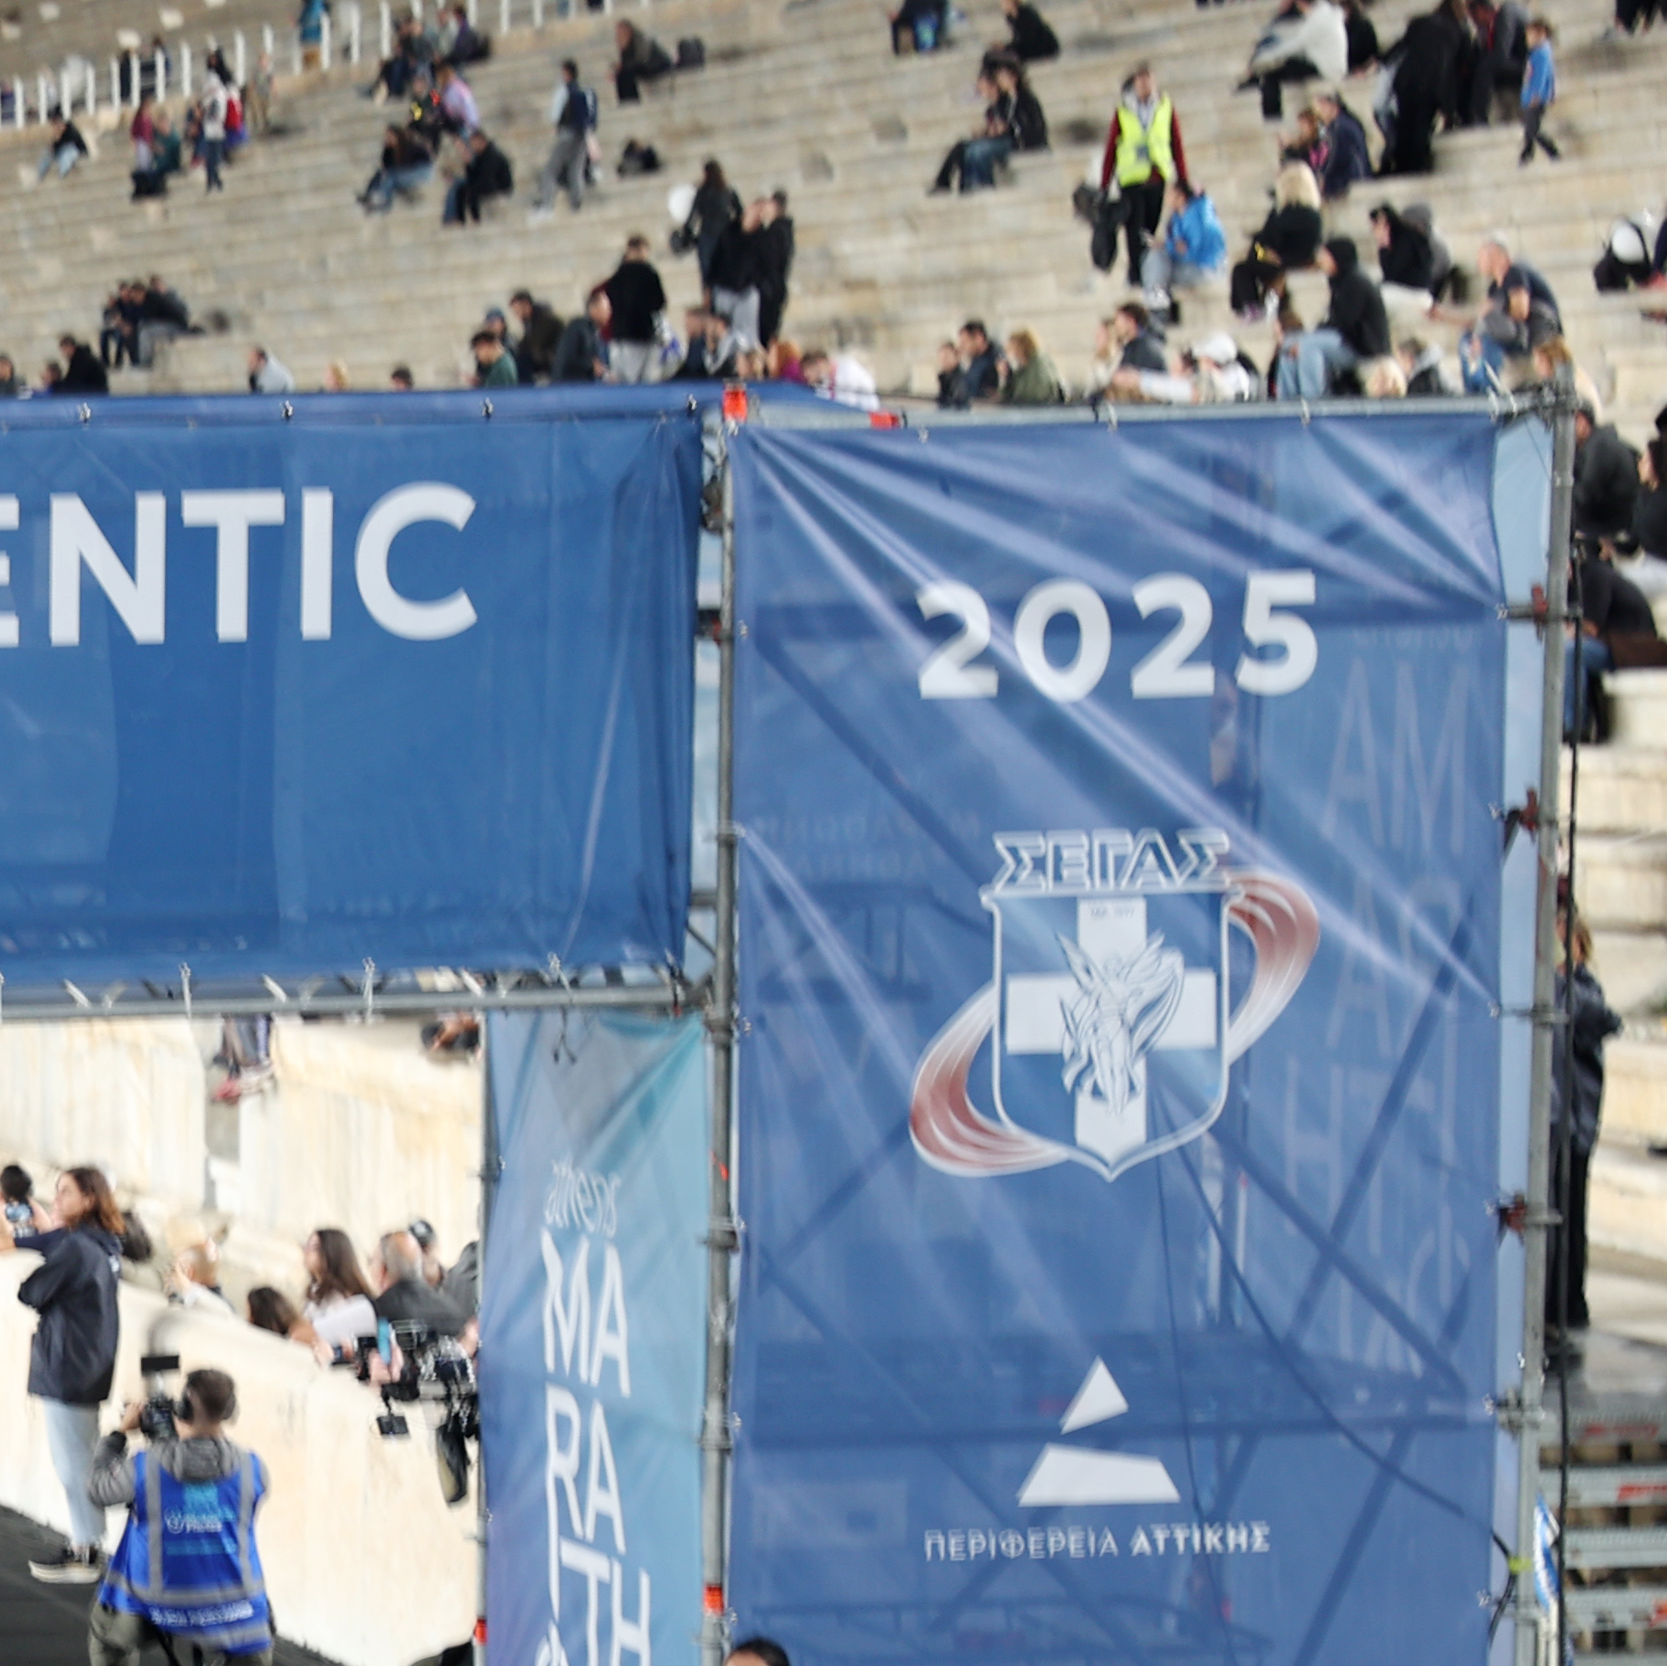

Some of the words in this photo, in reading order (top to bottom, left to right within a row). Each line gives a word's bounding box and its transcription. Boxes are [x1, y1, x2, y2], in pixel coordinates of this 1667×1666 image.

[916, 571, 1319, 701] 2025
[993, 828, 1230, 892] ΣΕΓΑΣ
[924, 1526, 1119, 1561] ΠΕΡΙΦΕΡΕΙΑ
[1129, 1520, 1272, 1557] ΑΤΤΙΚΗΣ
